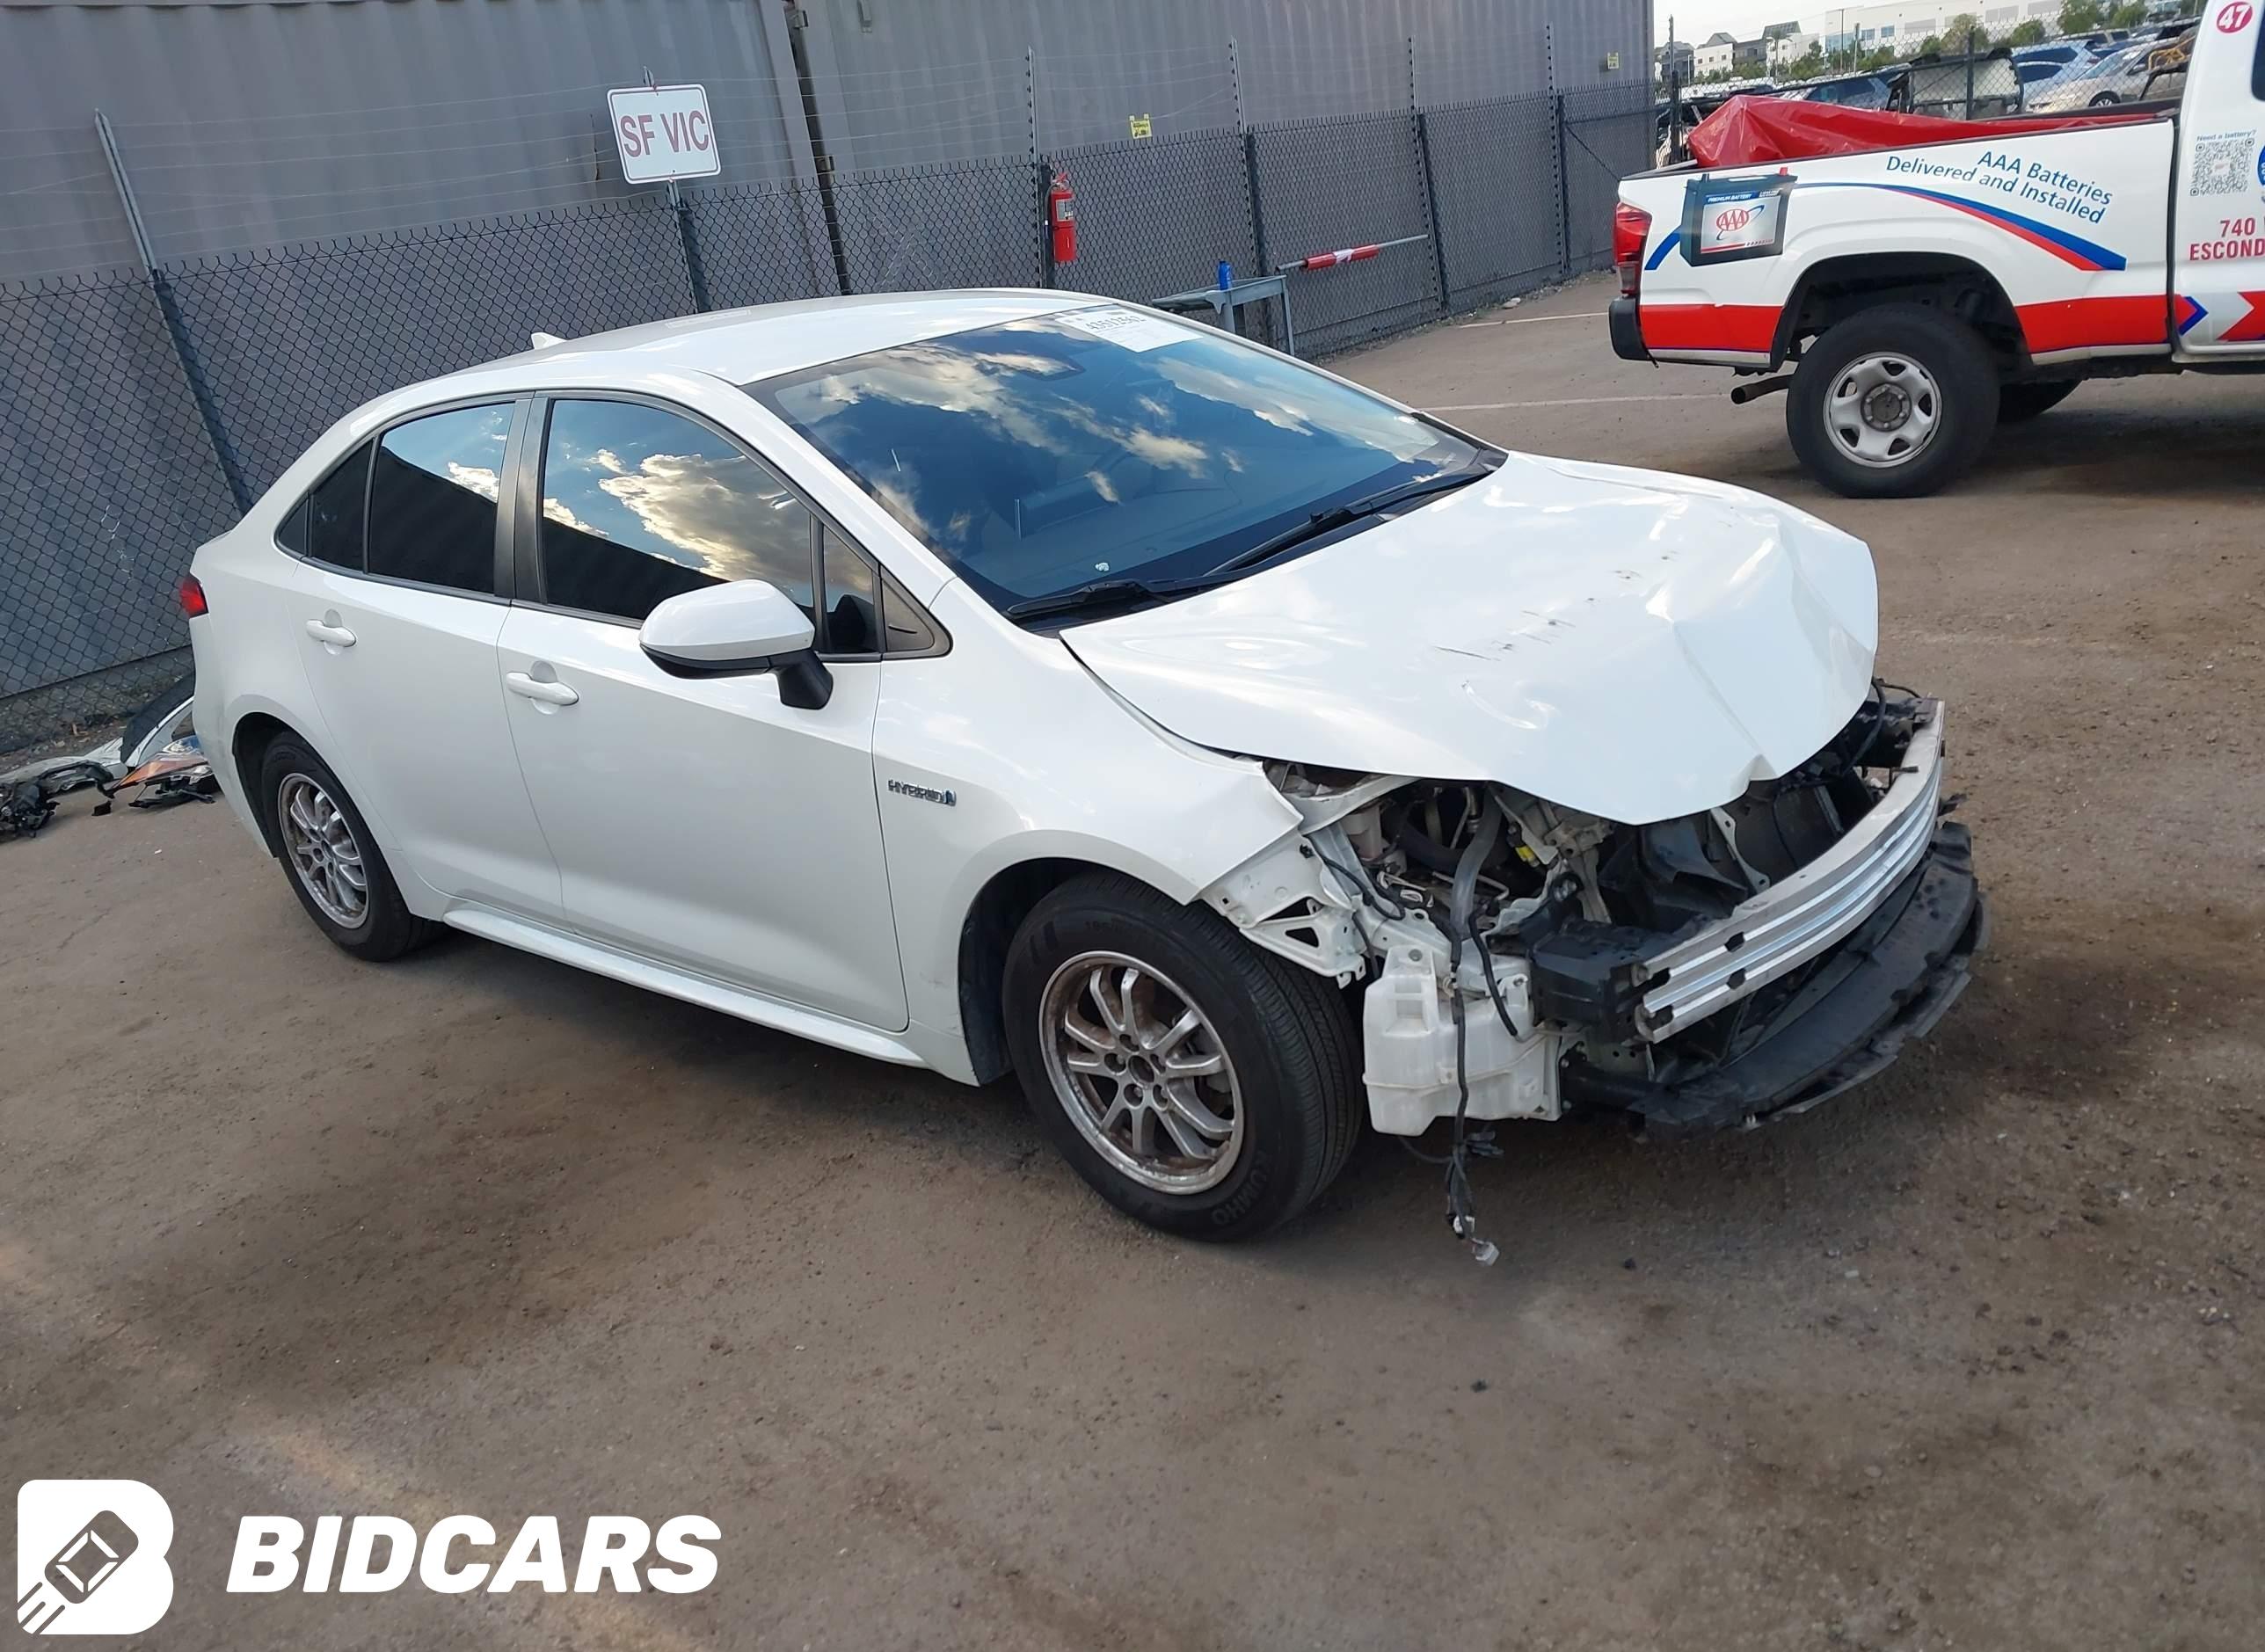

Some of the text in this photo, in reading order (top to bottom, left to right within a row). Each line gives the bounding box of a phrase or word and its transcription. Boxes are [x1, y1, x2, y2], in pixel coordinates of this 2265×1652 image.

[2218, 4, 2251, 30] 47
[620, 110, 710, 157] SF VIC
[1886, 156, 2106, 224] Delivered and Installed
[1977, 151, 2113, 205] AAA Batteries
[1720, 210, 1748, 231] AAA
[2219, 217, 2255, 237] 740
[2189, 237, 2265, 261] ESCOND
[888, 779, 943, 804] HYBRID
